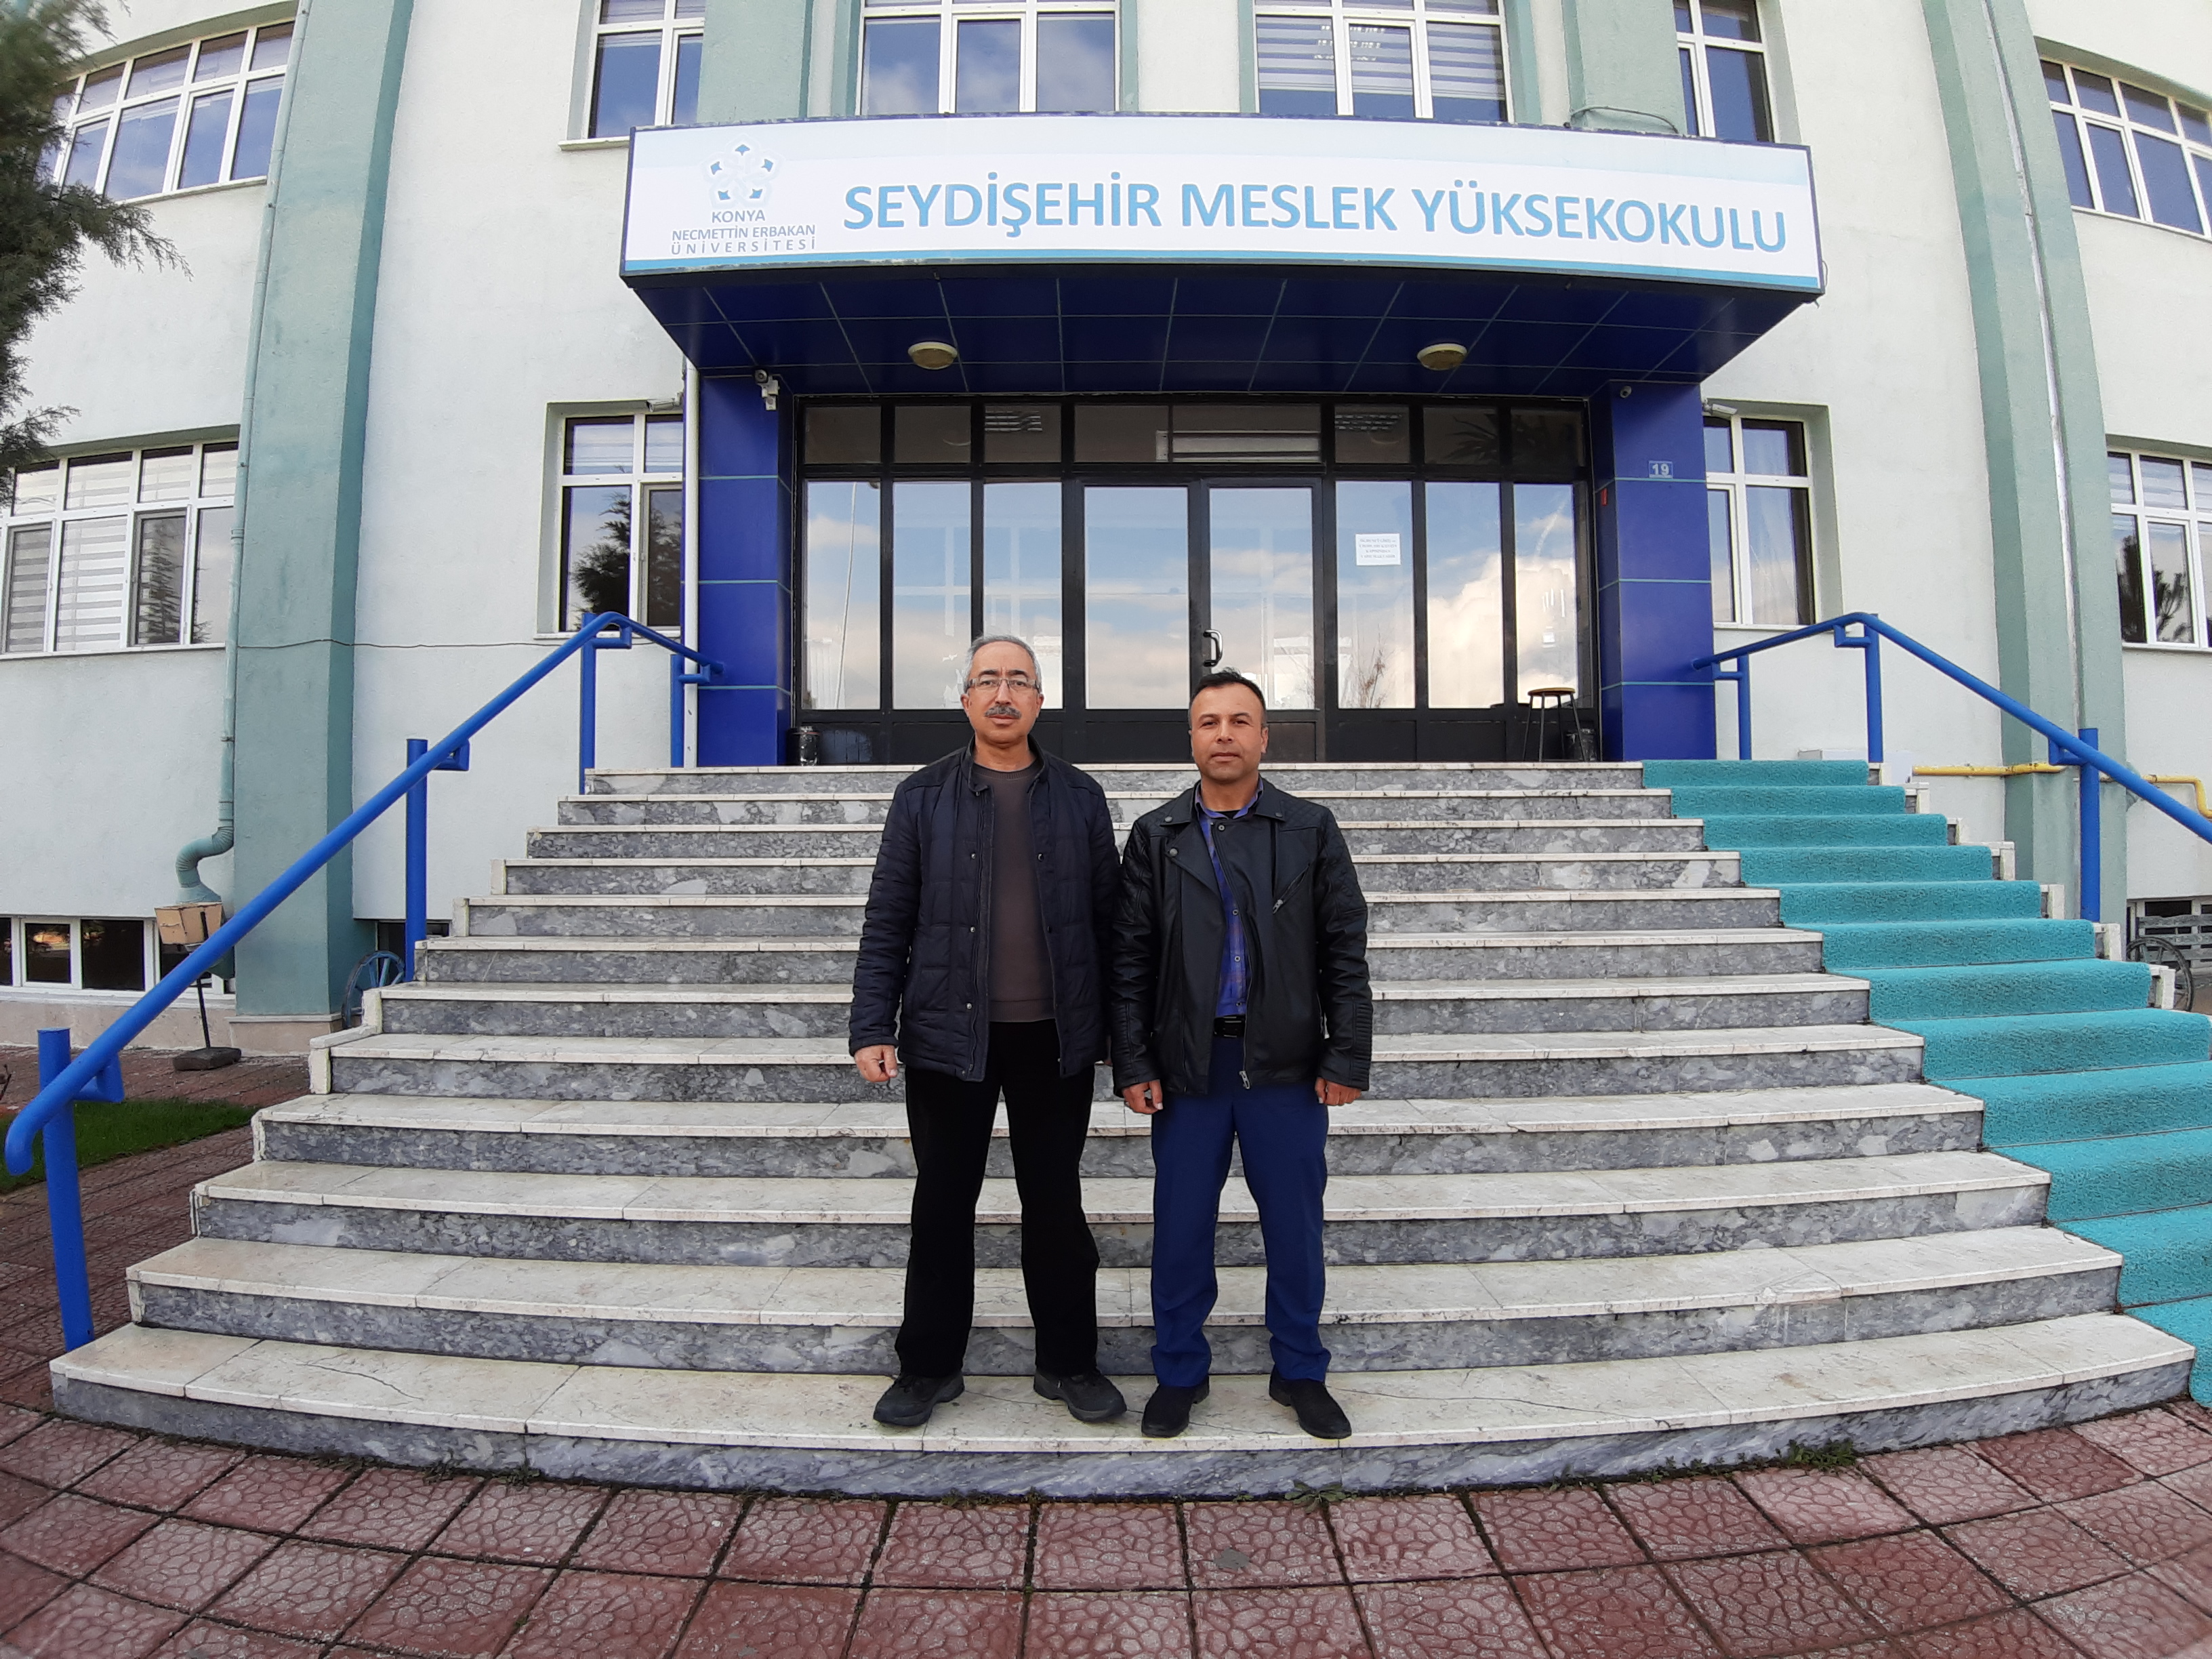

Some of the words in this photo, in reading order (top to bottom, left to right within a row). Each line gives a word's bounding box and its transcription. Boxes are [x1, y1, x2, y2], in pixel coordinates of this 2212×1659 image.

[712, 209, 766, 224] KONYA
[844, 171, 1162, 238] SEYDİŞEHİR
[1181, 183, 1398, 231] MESLEK
[1411, 180, 1786, 253] YÜKSEKOKULU
[672, 225, 748, 241] NECMETTİN
[753, 224, 815, 237] ERBAKAN
[672, 237, 815, 255] ÜNİVERSİTESİ
[1652, 463, 1670, 476] 19
